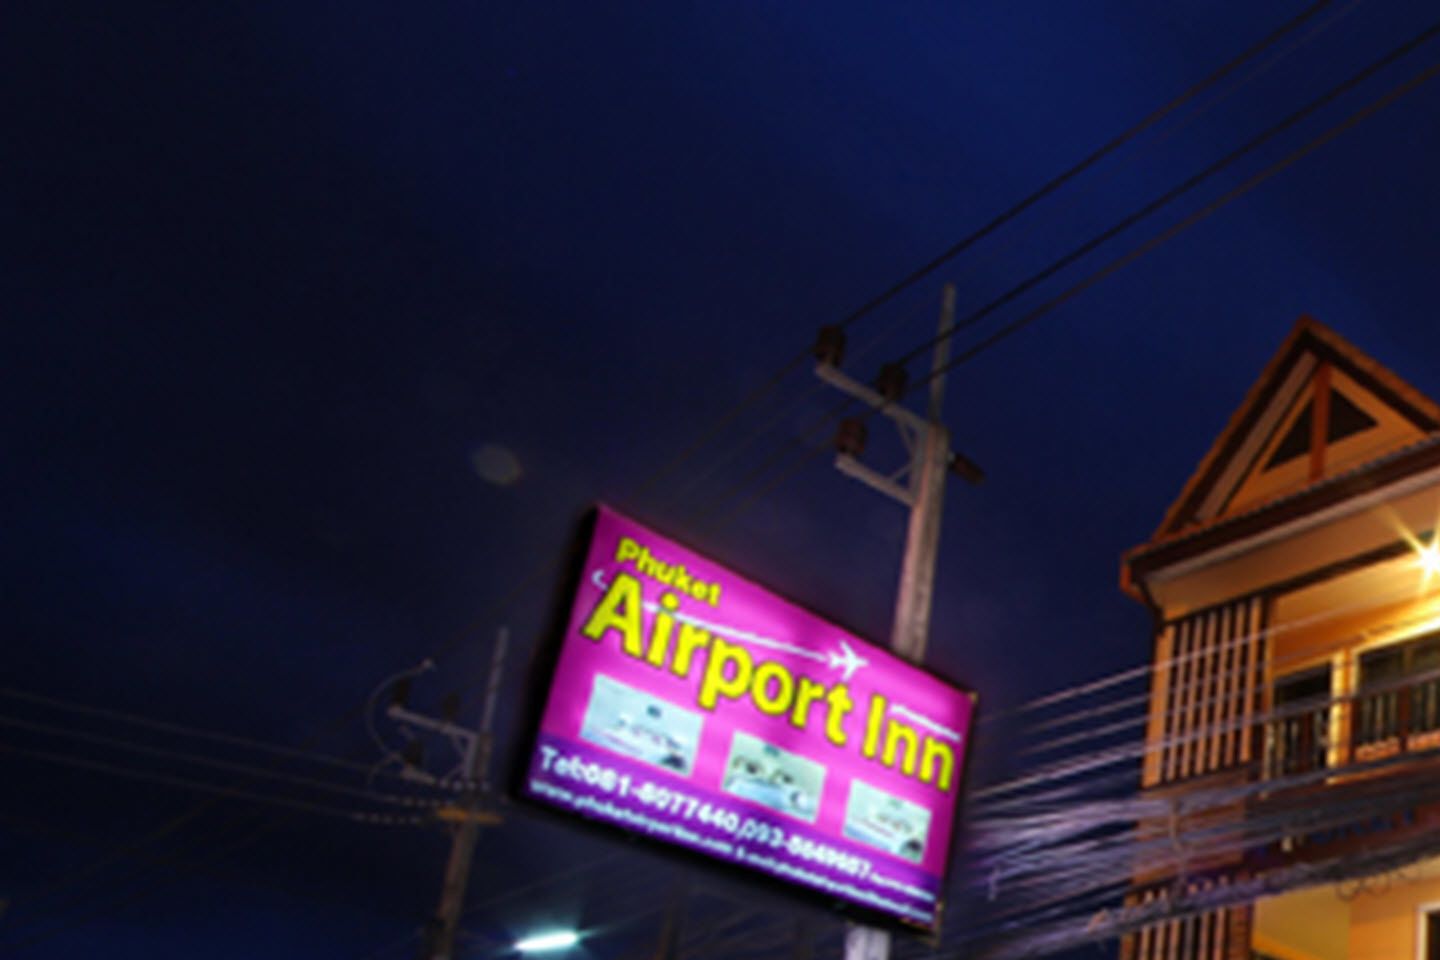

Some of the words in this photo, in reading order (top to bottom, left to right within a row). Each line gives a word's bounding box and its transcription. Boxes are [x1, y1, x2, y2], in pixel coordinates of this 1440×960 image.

[615, 537, 722, 608] Phuket
[581, 572, 853, 747] Airport
[861, 693, 957, 792] Inn
